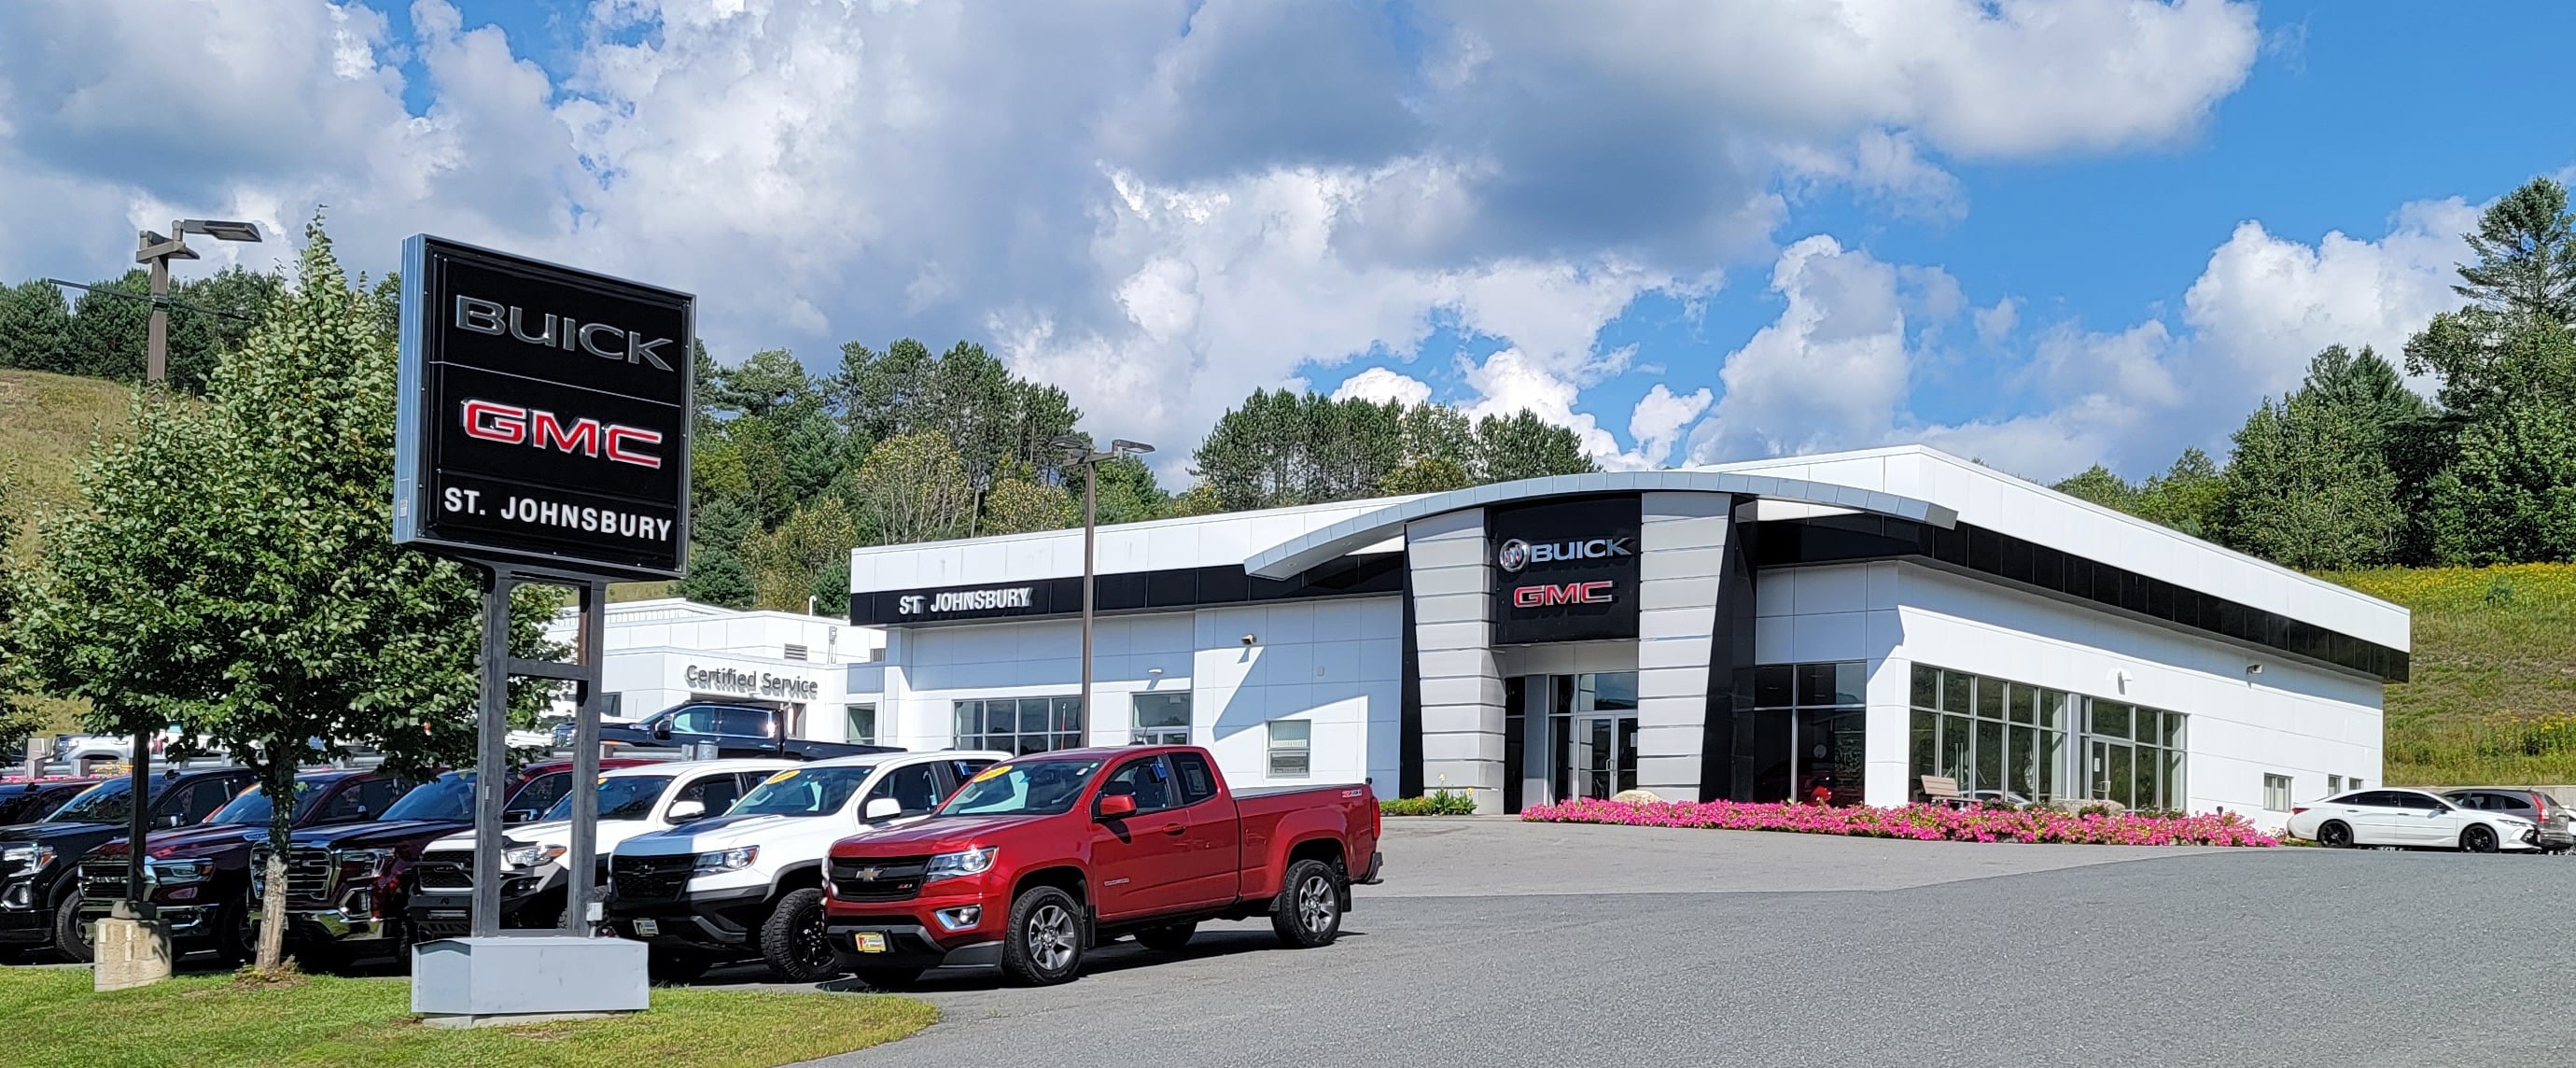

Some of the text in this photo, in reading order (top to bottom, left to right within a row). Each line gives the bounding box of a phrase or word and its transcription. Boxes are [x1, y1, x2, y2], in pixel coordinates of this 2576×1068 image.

[455, 294, 674, 372] BUICK
[462, 399, 662, 470] GMC
[444, 486, 486, 516] ST.
[500, 496, 672, 541] JOHNSBURY
[1531, 537, 1635, 562] BUICK
[899, 587, 1032, 614] ST JOHNSBURY
[1514, 580, 1614, 608] GMC
[686, 665, 819, 694] Certified Service
